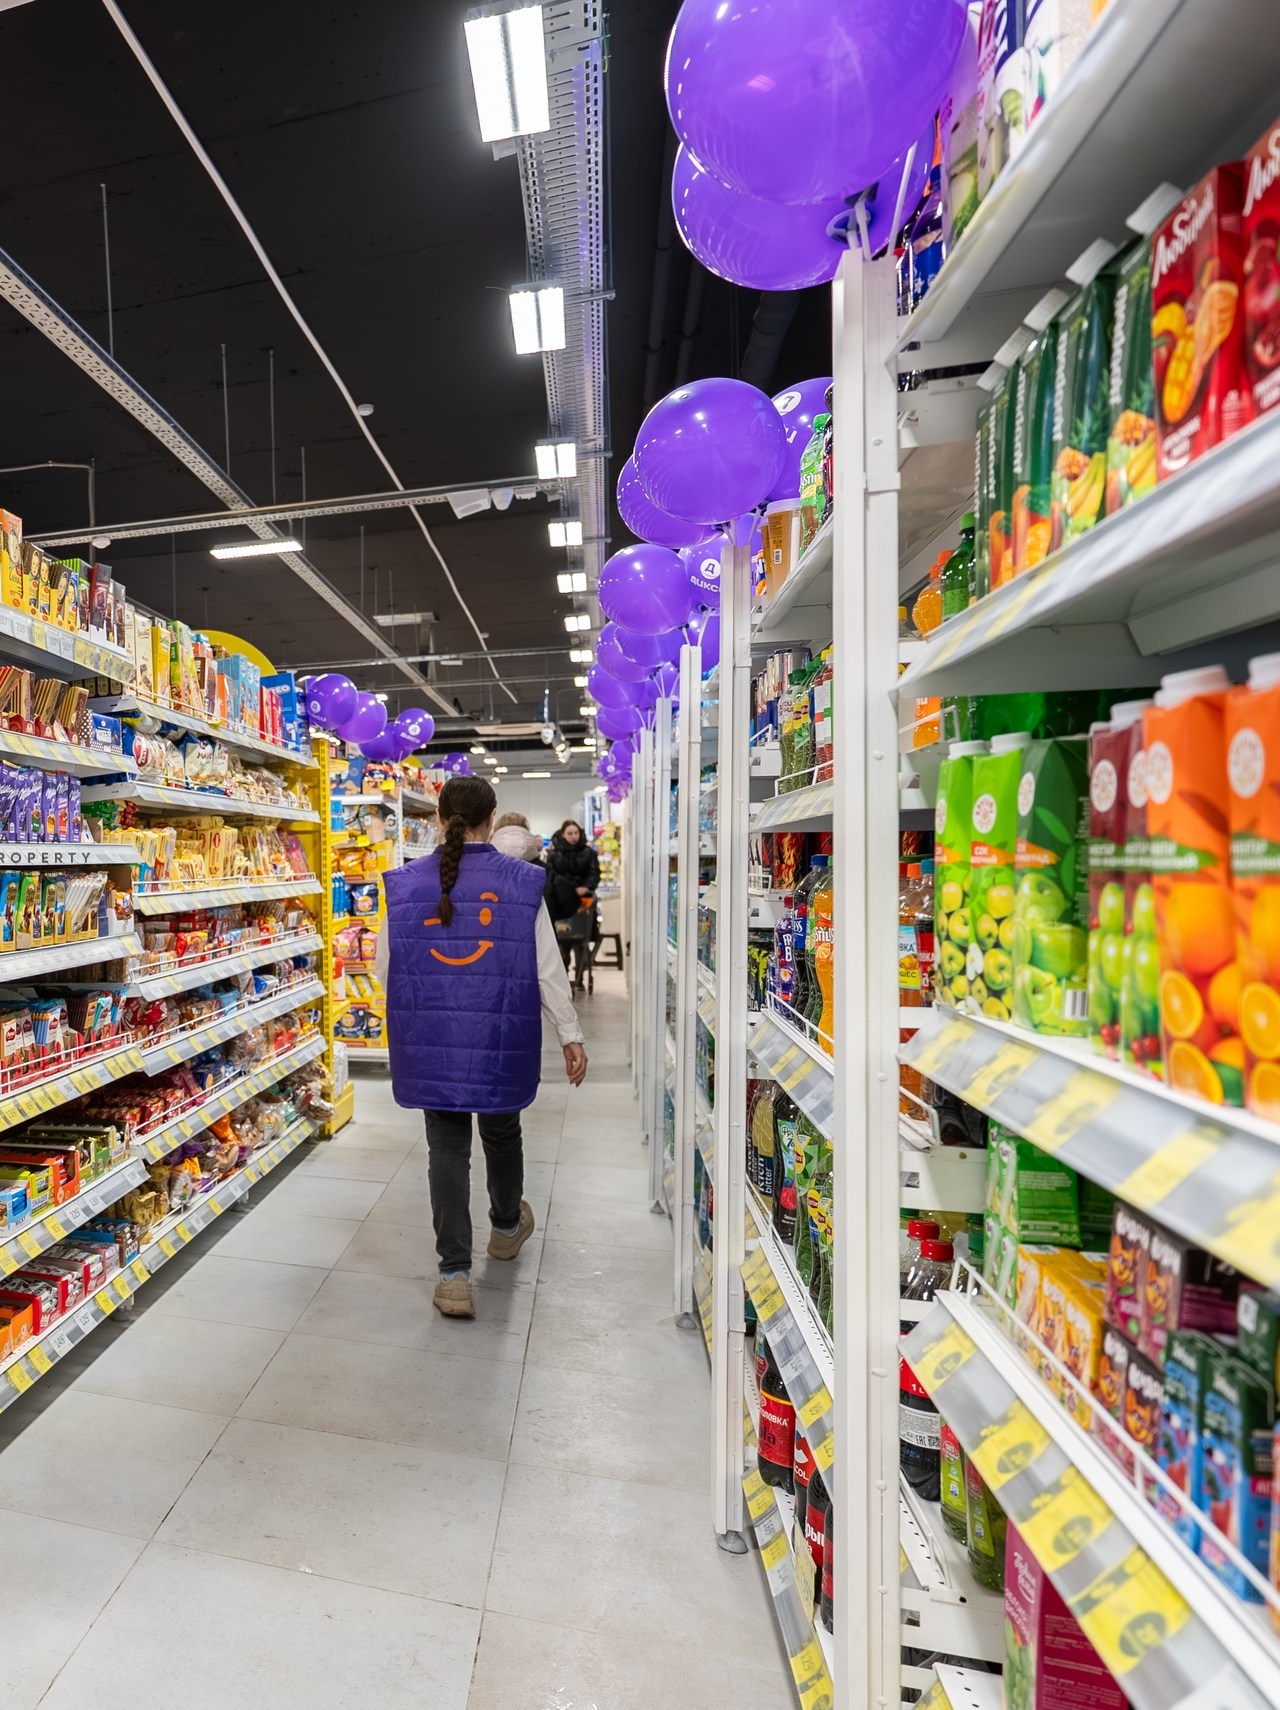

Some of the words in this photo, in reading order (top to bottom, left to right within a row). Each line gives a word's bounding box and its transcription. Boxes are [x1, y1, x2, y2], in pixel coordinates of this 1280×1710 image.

[704, 563, 715, 574] Д
[690, 575, 720, 593] ДИКС
[764, 1167, 772, 1195] bitter
